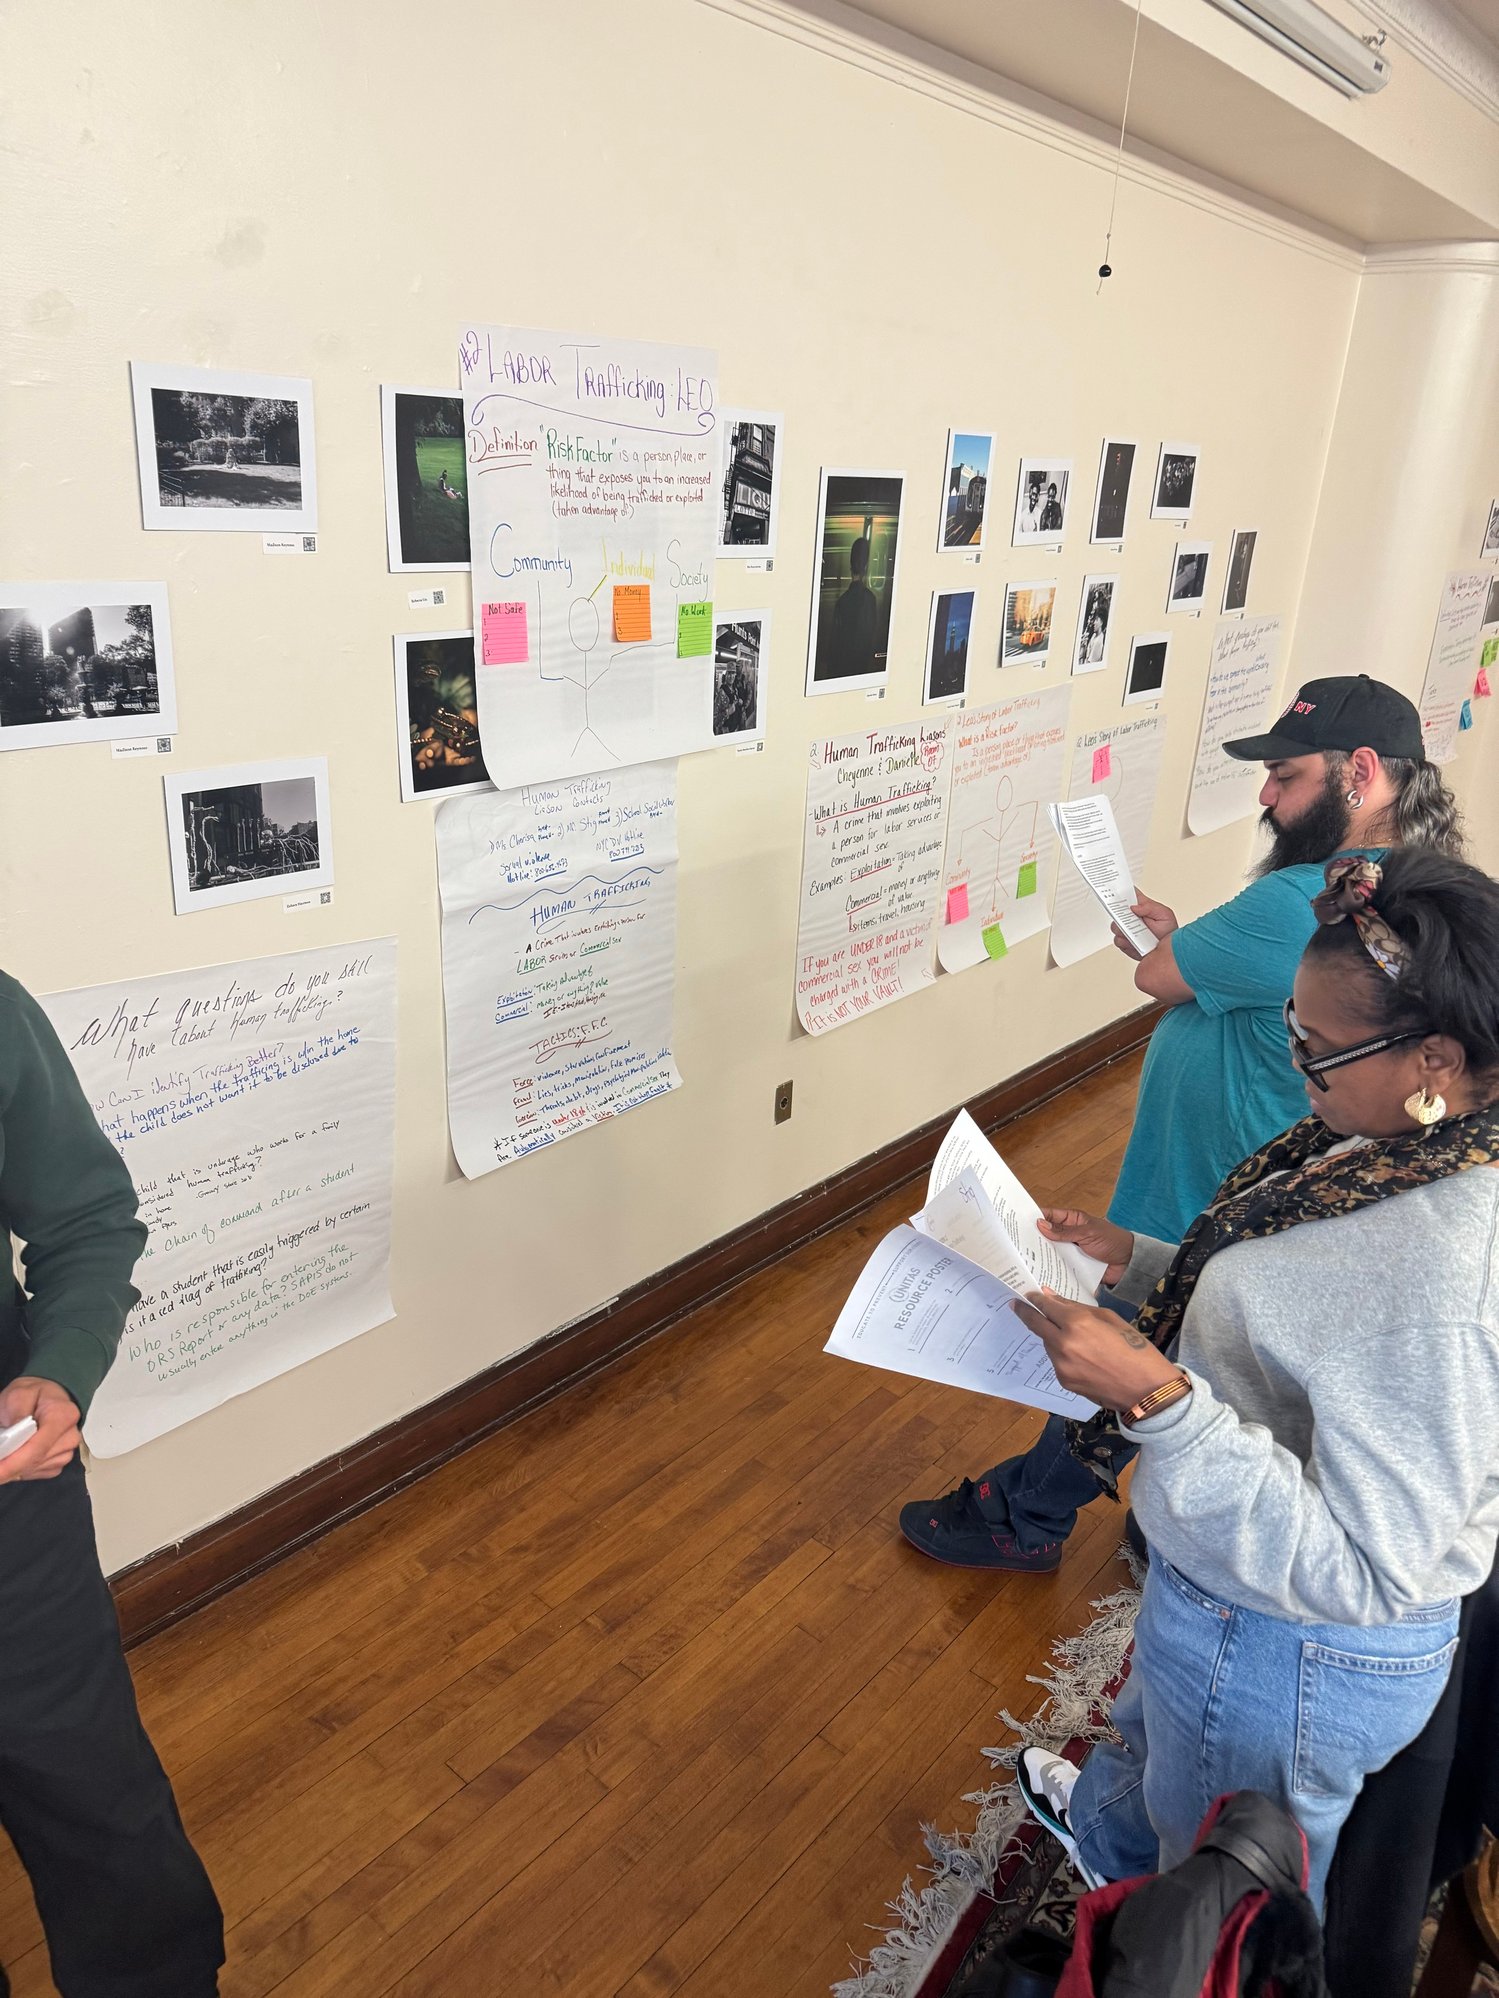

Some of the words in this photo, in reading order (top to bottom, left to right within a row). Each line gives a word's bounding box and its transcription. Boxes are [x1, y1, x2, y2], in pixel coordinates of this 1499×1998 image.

[459, 331, 482, 375] #2
[488, 333, 557, 386] LABOR
[677, 368, 713, 411] LEO
[468, 427, 538, 463] Definition
[620, 446, 629, 461] is
[697, 451, 706, 462] or
[546, 463, 571, 481] thing
[576, 466, 596, 484] that
[599, 472, 633, 488] exposes
[637, 474, 651, 492] you
[653, 471, 662, 484] to
[663, 474, 674, 485] an
[677, 469, 711, 485] increased
[550, 483, 588, 498] likelihood
[592, 486, 601, 499] of
[603, 490, 625, 506] being
[628, 488, 663, 505] trafficked
[552, 503, 579, 519] (taken
[582, 504, 618, 522] advantage
[490, 523, 573, 588] Community
[667, 539, 709, 603] Society
[488, 604, 502, 615] Not
[505, 602, 523, 614] Safe
[624, 587, 642, 602] Money
[1294, 700, 1317, 715] NY
[824, 741, 859, 764] Human
[866, 733, 916, 759] Trafficking
[565, 777, 612, 796] Trafficking
[837, 767, 874, 789] Cheyenne
[814, 805, 836, 821] What
[854, 791, 882, 809] Human
[888, 776, 937, 799] Trafficking?
[845, 817, 864, 829] crime
[867, 811, 883, 823] that
[886, 802, 910, 816] involves
[840, 834, 864, 851] person
[868, 830, 878, 840] for
[885, 822, 902, 834] labor
[875, 841, 889, 852] sex
[850, 857, 892, 879] Exploitation
[530, 899, 576, 925] HUMAN
[845, 886, 882, 912] Commercial
[516, 956, 547, 973] LABOR
[815, 958, 829, 974] you
[832, 950, 845, 962] are
[850, 939, 874, 956] UNDER
[885, 930, 898, 945] and
[798, 965, 843, 993] commercial
[848, 962, 862, 974] sex
[866, 954, 879, 966] you
[899, 942, 911, 954] not
[175, 981, 262, 1028] questions
[275, 972, 296, 996] do
[307, 970, 330, 994] you
[338, 954, 374, 983] still
[810, 984, 838, 1007] charged
[842, 977, 859, 994] with
[827, 1012, 837, 1022] is
[835, 1001, 851, 1019] NOT
[852, 993, 874, 1011] YOUR
[127, 1037, 156, 1082] have
[134, 1088, 145, 1100] I
[193, 1064, 245, 1085] Trafficking
[247, 1042, 285, 1067] Better?
[115, 1131, 136, 1142] the
[139, 1119, 167, 1135] child
[172, 1111, 193, 1125] does
[196, 1099, 215, 1114] not
[219, 1088, 246, 1104] want
[249, 1079, 260, 1090] it
[276, 1068, 288, 1079] be
[331, 1044, 346, 1056] due
[348, 1036, 359, 1046] to
[130, 1101, 176, 1124] happens
[180, 1091, 208, 1109] when
[211, 1080, 229, 1095] the
[282, 1053, 293, 1065] is
[318, 1033, 334, 1046] the
[336, 1025, 361, 1042] home
[220, 1203, 263, 1229] command
[320, 1164, 355, 1188] student
[172, 1271, 208, 1294] student
[212, 1259, 233, 1276] that
[248, 1245, 274, 1265] easily
[277, 1221, 320, 1247] triggered
[328, 1244, 349, 1259] the
[894, 1267, 921, 1299] UNITAS
[894, 1280, 932, 1330] RESOURCE
[158, 1360, 198, 1382] usually
